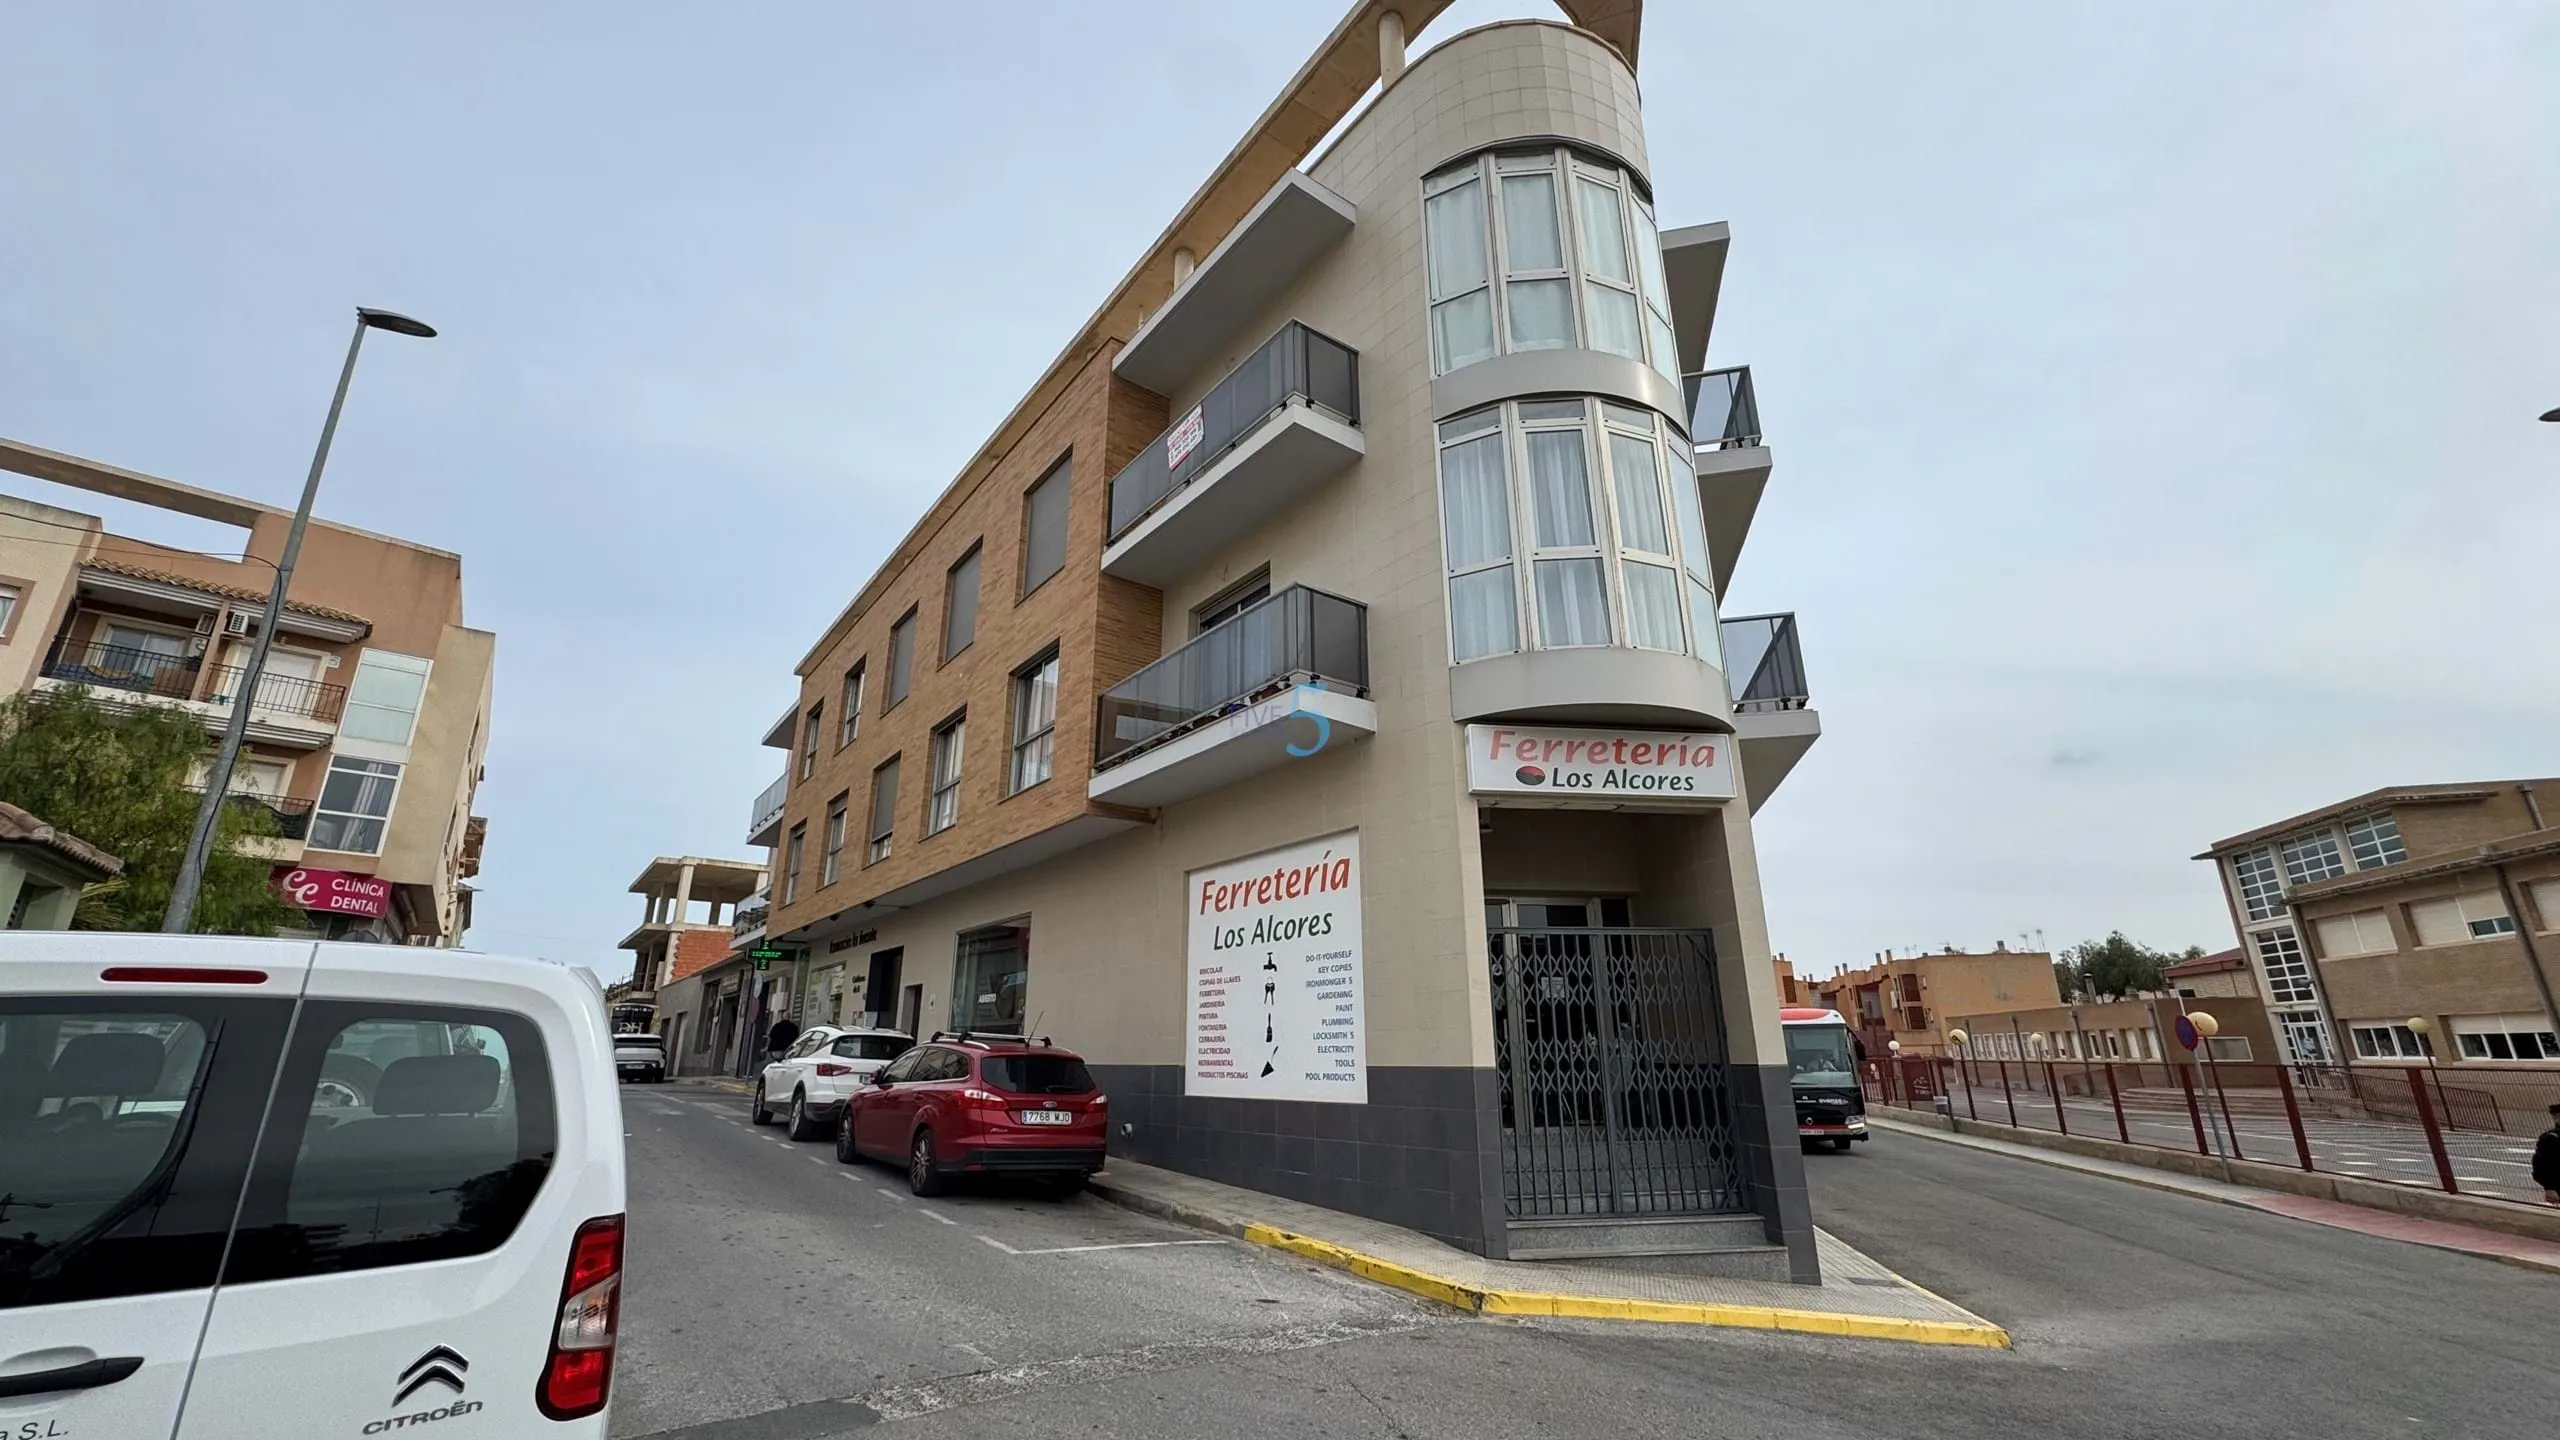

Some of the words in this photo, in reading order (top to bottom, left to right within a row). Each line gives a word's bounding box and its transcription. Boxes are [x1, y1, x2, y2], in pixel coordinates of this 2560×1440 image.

[1489, 727, 1716, 768] Ferretería
[1552, 767, 1593, 788] Los
[1602, 768, 1695, 791] Alcores
[331, 878, 384, 897] CLÍNICA
[1200, 849, 1351, 915] Ferretería
[330, 895, 378, 914] DENTAL
[1214, 925, 1245, 950] Los
[1250, 912, 1333, 945] Alcores
[1318, 966, 1330, 974] KEY
[1331, 963, 1353, 973] COPIES
[1317, 990, 1353, 1000] GARDENING
[1335, 1003, 1353, 1012] PAINT
[1321, 1017, 1354, 1026] PLUMBING
[1317, 1045, 1355, 1054] ELECTRICITY
[1335, 1059, 1355, 1067] TOOLS
[1305, 1072, 1321, 1081] POOL
[1322, 1073, 1356, 1082] PRODUCTS
[1028, 1111, 1050, 1122] 7768
[18, 1419, 70, 1440] S.L.
